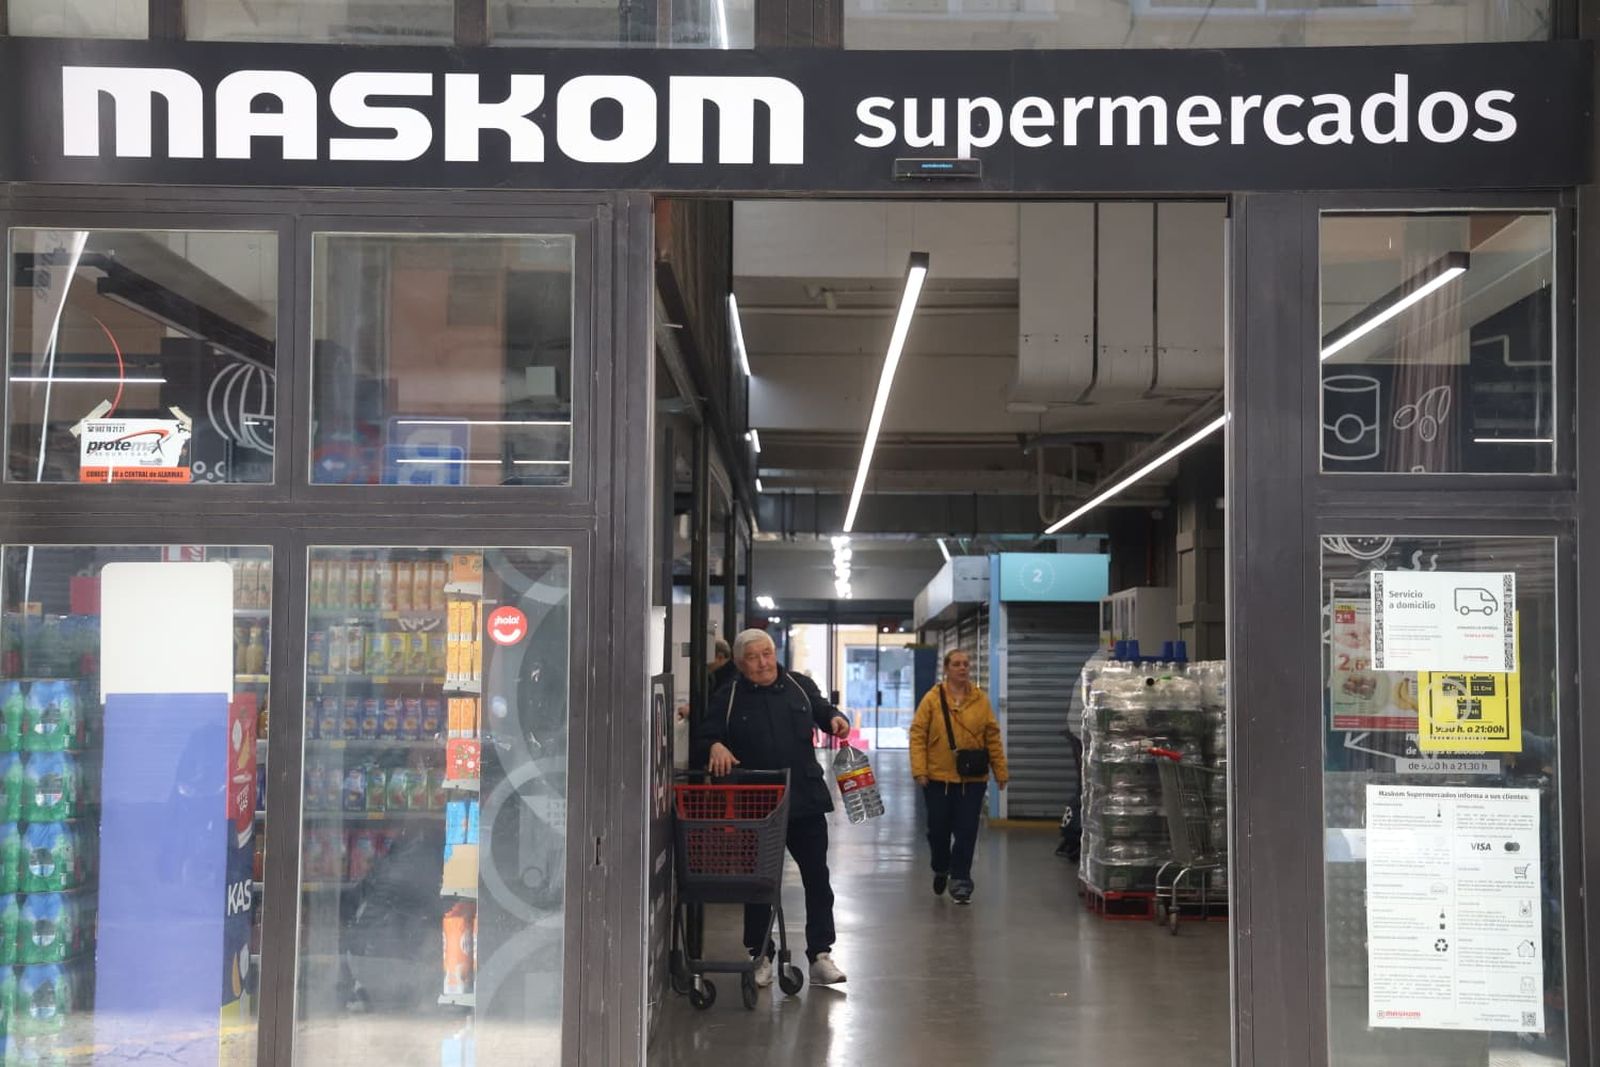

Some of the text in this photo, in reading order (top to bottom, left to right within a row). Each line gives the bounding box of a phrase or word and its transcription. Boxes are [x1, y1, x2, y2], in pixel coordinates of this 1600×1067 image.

[63, 66, 1518, 165] MASKOM supermercados
[1033, 569, 1042, 583] 2
[1388, 590, 1423, 599] Servicio
[1396, 600, 1436, 610] domicilio
[1408, 762, 1419, 770] de
[1442, 761, 1448, 770] h
[1481, 761, 1488, 770] h
[1406, 790, 1457, 799] Supermercados
[1457, 791, 1484, 799] informa
[1470, 842, 1492, 851] VISA
[228, 879, 252, 916] KAS
